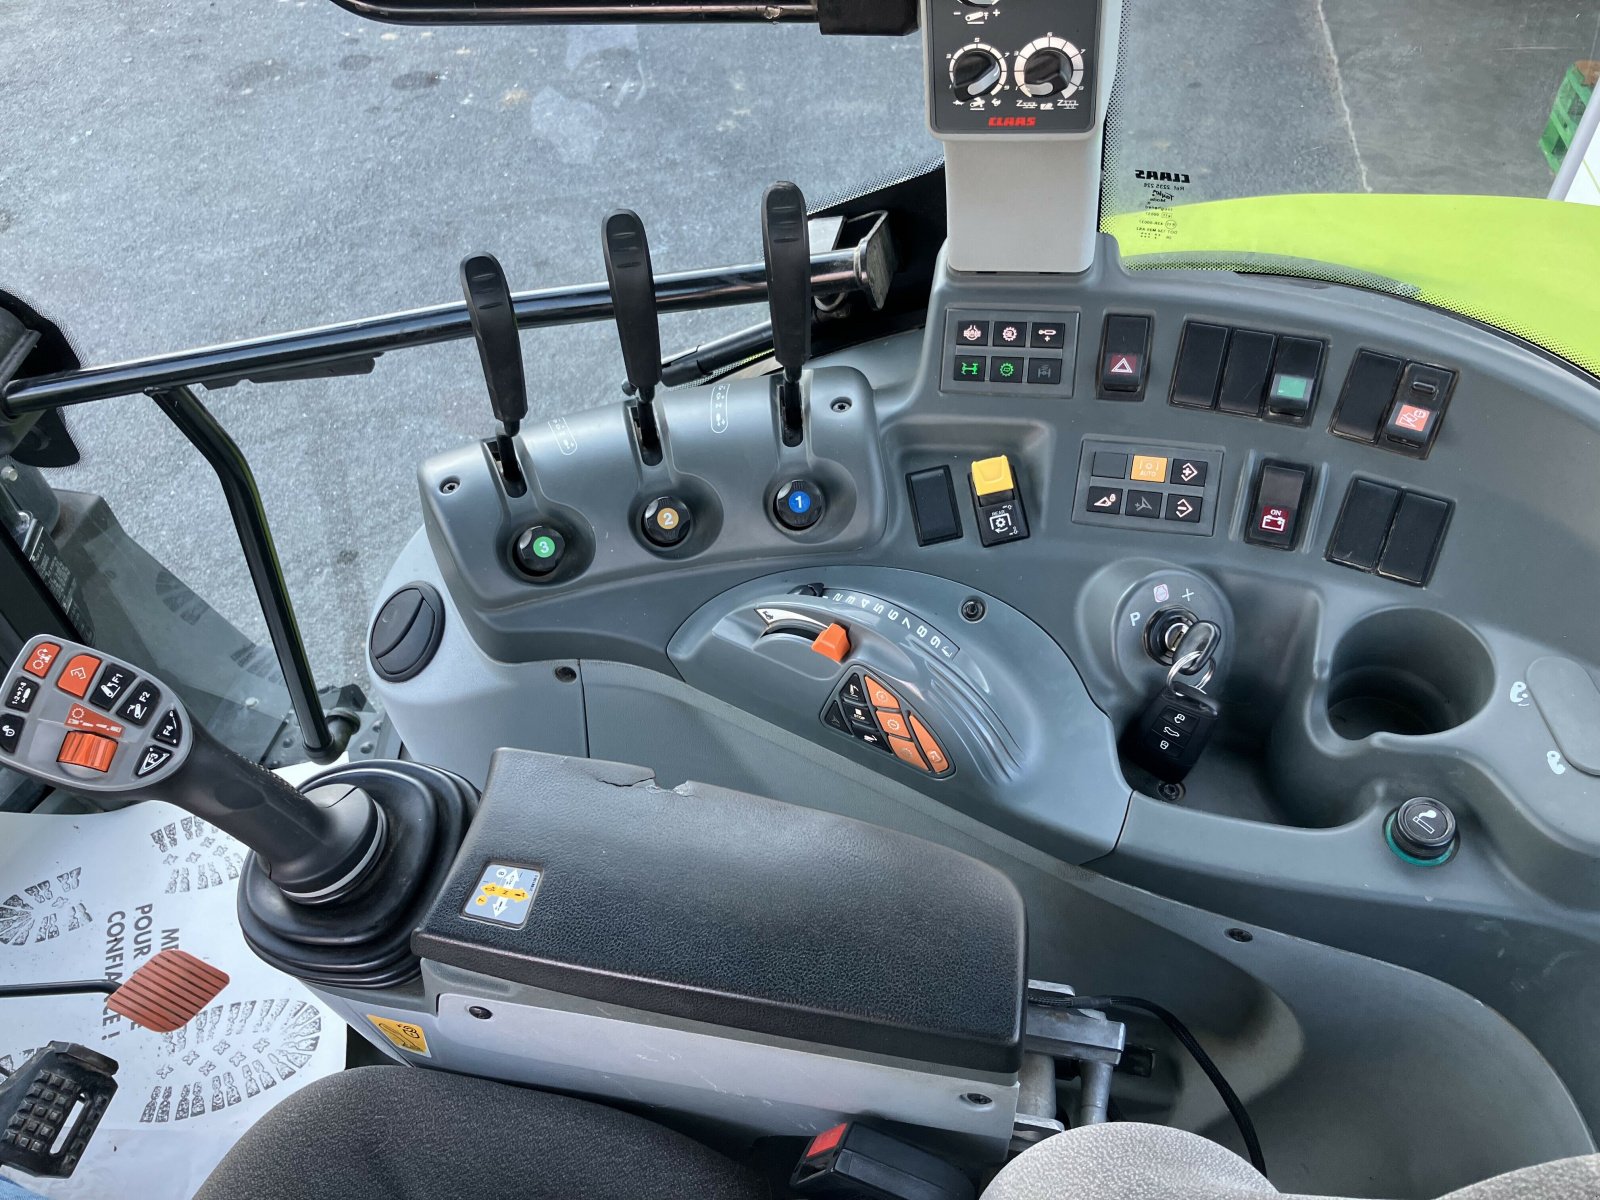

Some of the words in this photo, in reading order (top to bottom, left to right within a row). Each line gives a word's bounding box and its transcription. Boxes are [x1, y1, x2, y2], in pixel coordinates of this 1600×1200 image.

[988, 117, 1036, 127] CLAAS
[795, 495, 802, 508] 1
[663, 512, 673, 526] 2
[540, 541, 549, 553] 3
[832, 592, 844, 602] 2
[845, 595, 856, 605] 3
[861, 598, 870, 609] 4
[873, 602, 884, 615] 5
[887, 608, 899, 621] 6
[901, 616, 911, 629] 7
[916, 625, 928, 638] 8
[930, 635, 941, 649] 9
[1130, 611, 1140, 627] P
[111, 673, 124, 683] F1
[139, 691, 151, 702] F2
[162, 725, 174, 736] F4
[148, 753, 159, 764] F3
[133, 903, 153, 960] POUR
[103, 910, 126, 1027] CONFIAE
